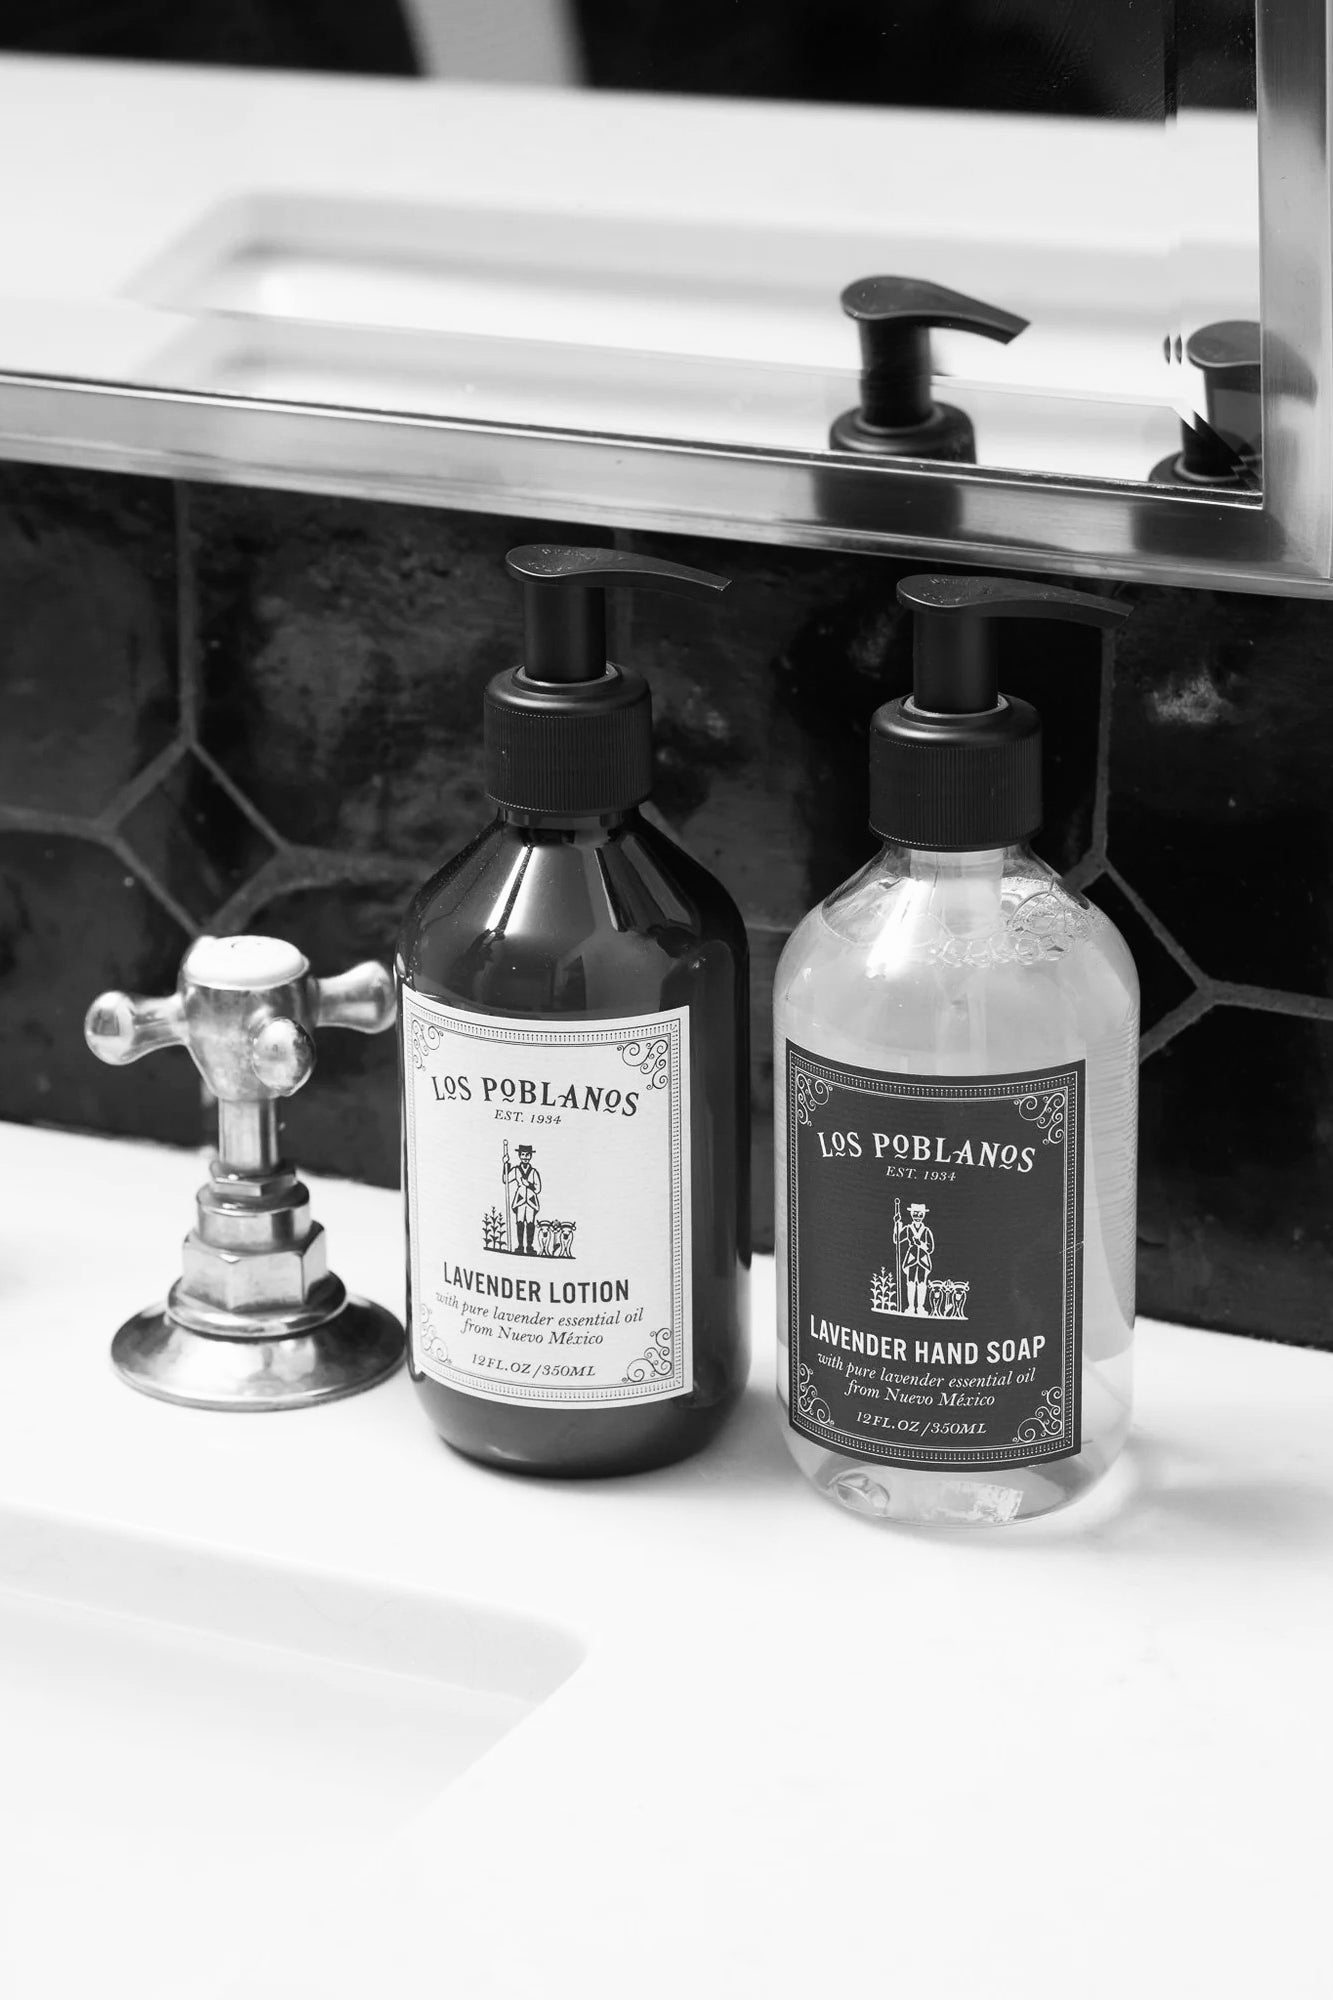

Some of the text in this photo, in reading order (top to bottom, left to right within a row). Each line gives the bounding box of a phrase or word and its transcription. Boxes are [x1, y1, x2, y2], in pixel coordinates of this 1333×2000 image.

[431, 1075, 640, 1117] LOS POBLANOS
[493, 1109, 562, 1125] EST. 1934
[816, 1131, 1036, 1173] LOS POBLANOS
[886, 1165, 957, 1182] EST. 1934
[443, 1261, 629, 1304] LAVENDER LOTION
[435, 1291, 645, 1327] with pure lavender essential oil
[460, 1318, 604, 1345] from Nuevo México
[809, 1314, 1046, 1365] LAVENDER HAND SOAP
[817, 1352, 1036, 1389] with pure lavender essential oil
[843, 1379, 995, 1407] from Nuevo México
